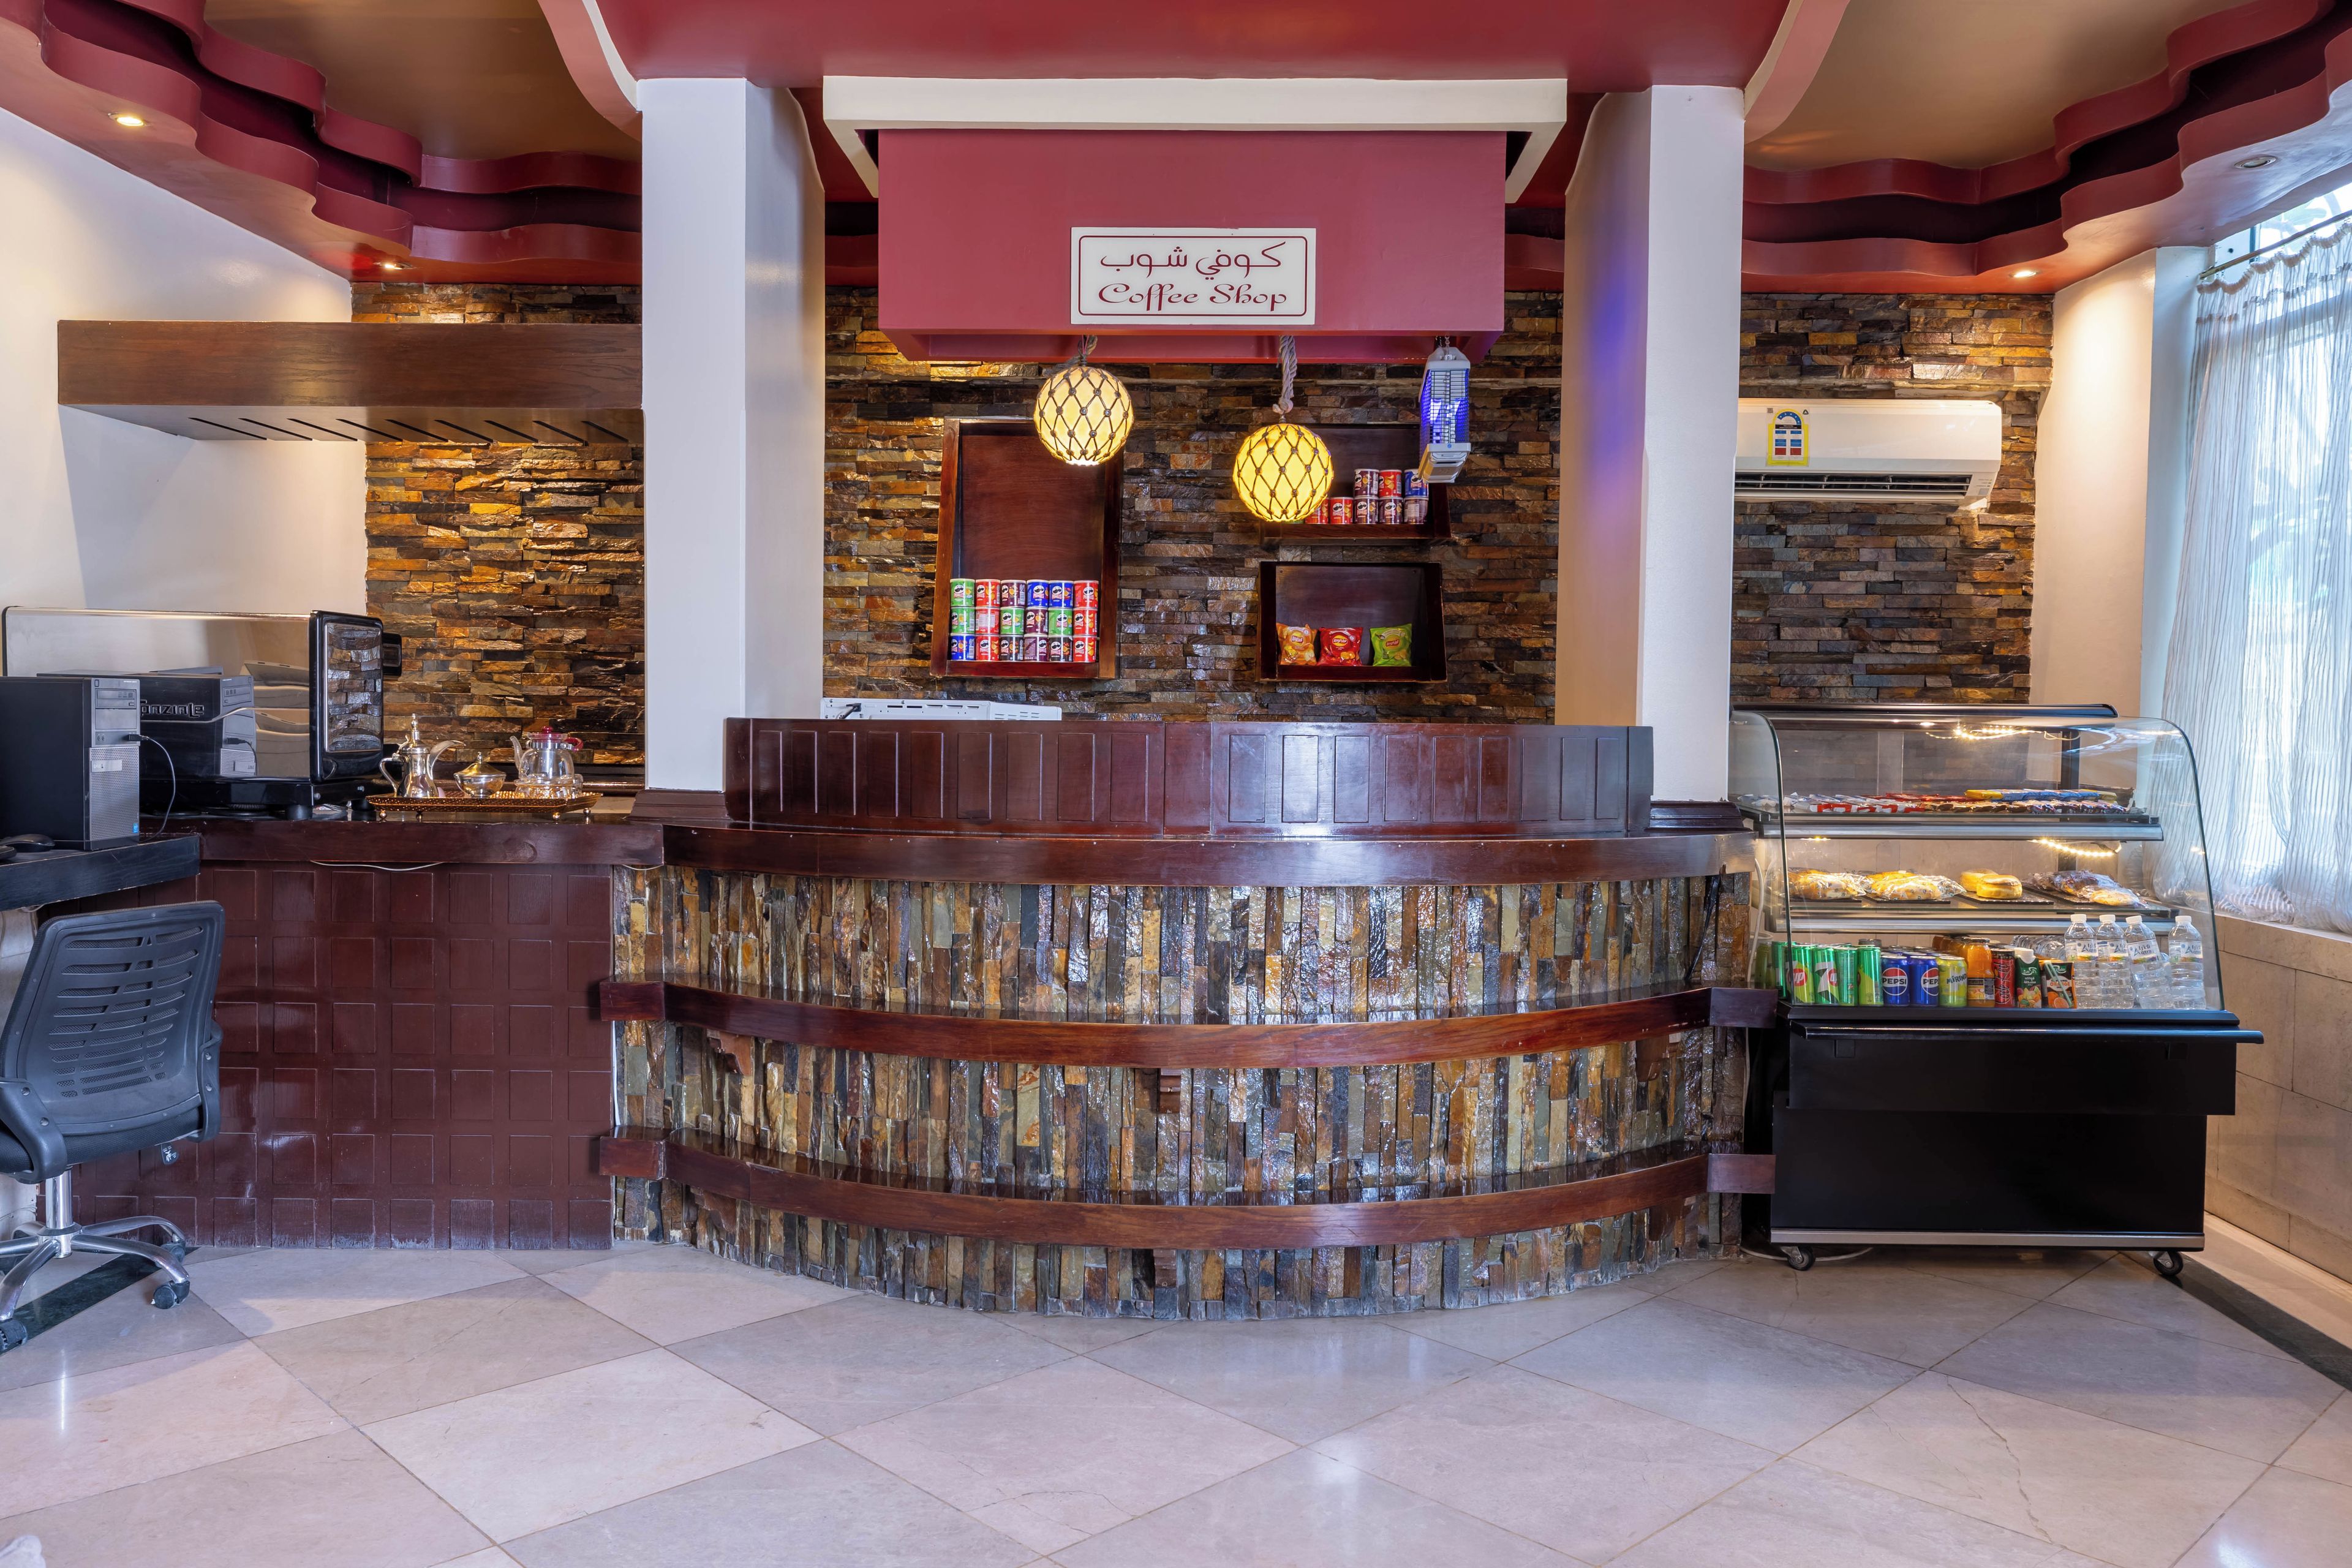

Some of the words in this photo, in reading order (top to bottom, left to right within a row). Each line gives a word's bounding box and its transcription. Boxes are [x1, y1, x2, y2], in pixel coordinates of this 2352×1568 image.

[1100, 246, 1188, 278] شوب
[1195, 241, 1286, 281] كوفي
[1098, 283, 1199, 312] Coffee
[1209, 283, 1287, 312] Shop
